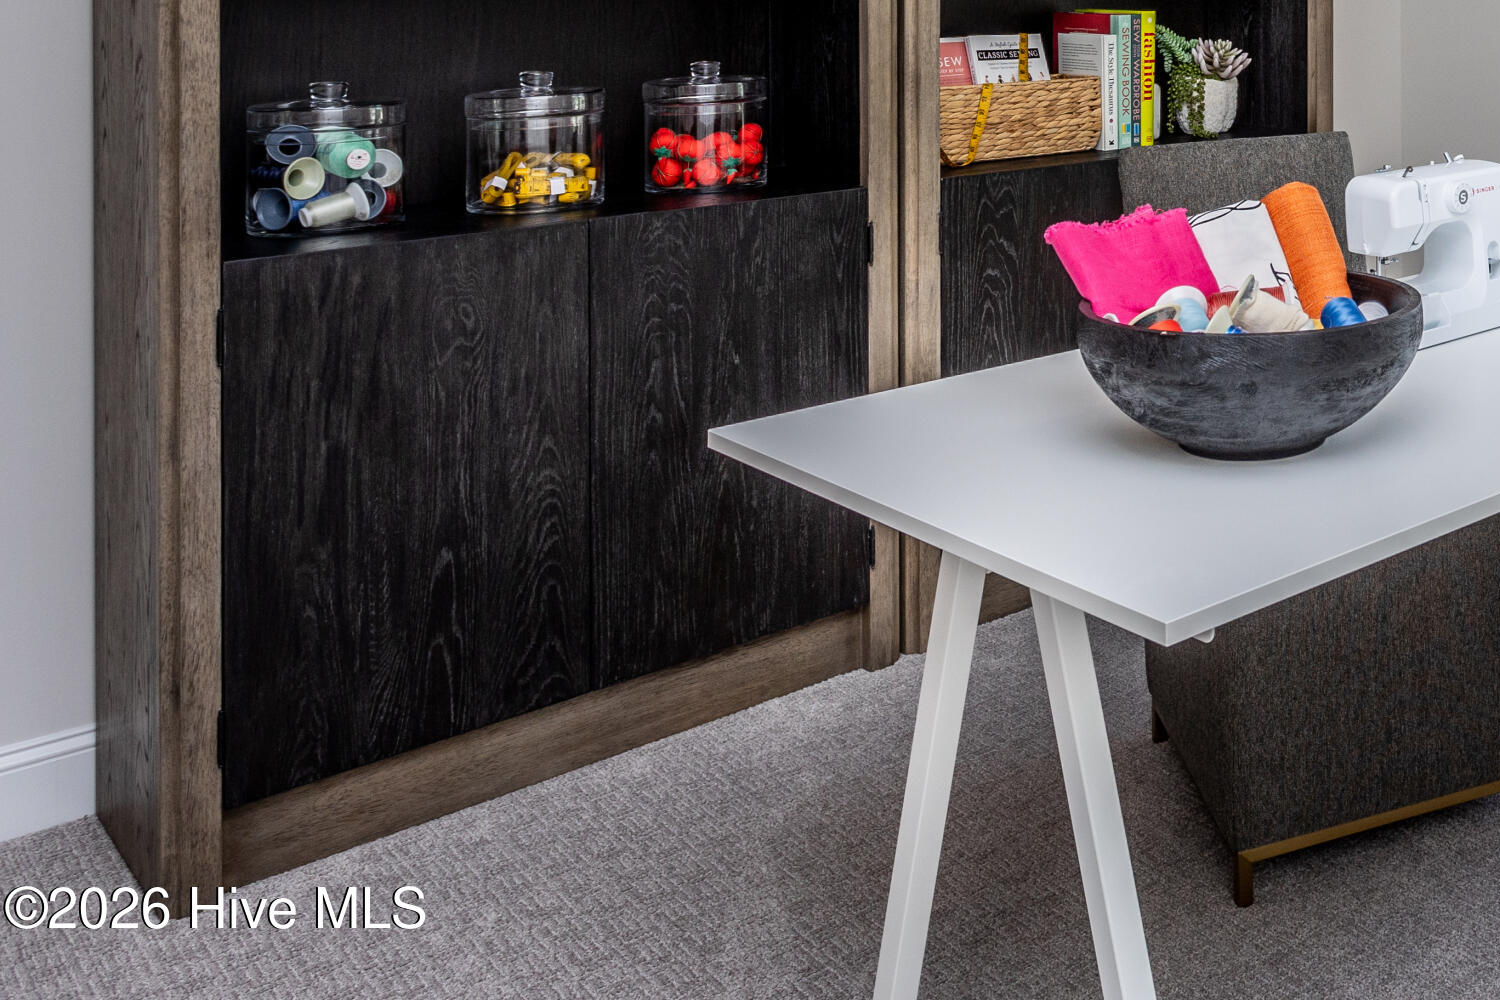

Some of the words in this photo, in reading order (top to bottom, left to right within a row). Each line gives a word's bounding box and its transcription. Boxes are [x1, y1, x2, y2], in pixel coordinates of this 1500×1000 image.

[978, 52, 1008, 60] CLASSIC
[1009, 50, 1039, 59] SENG
[1107, 58, 1115, 76] Style
[1121, 27, 1130, 77] SEWING
[1143, 32, 1155, 101] fashion
[1121, 80, 1130, 116] BOOK
